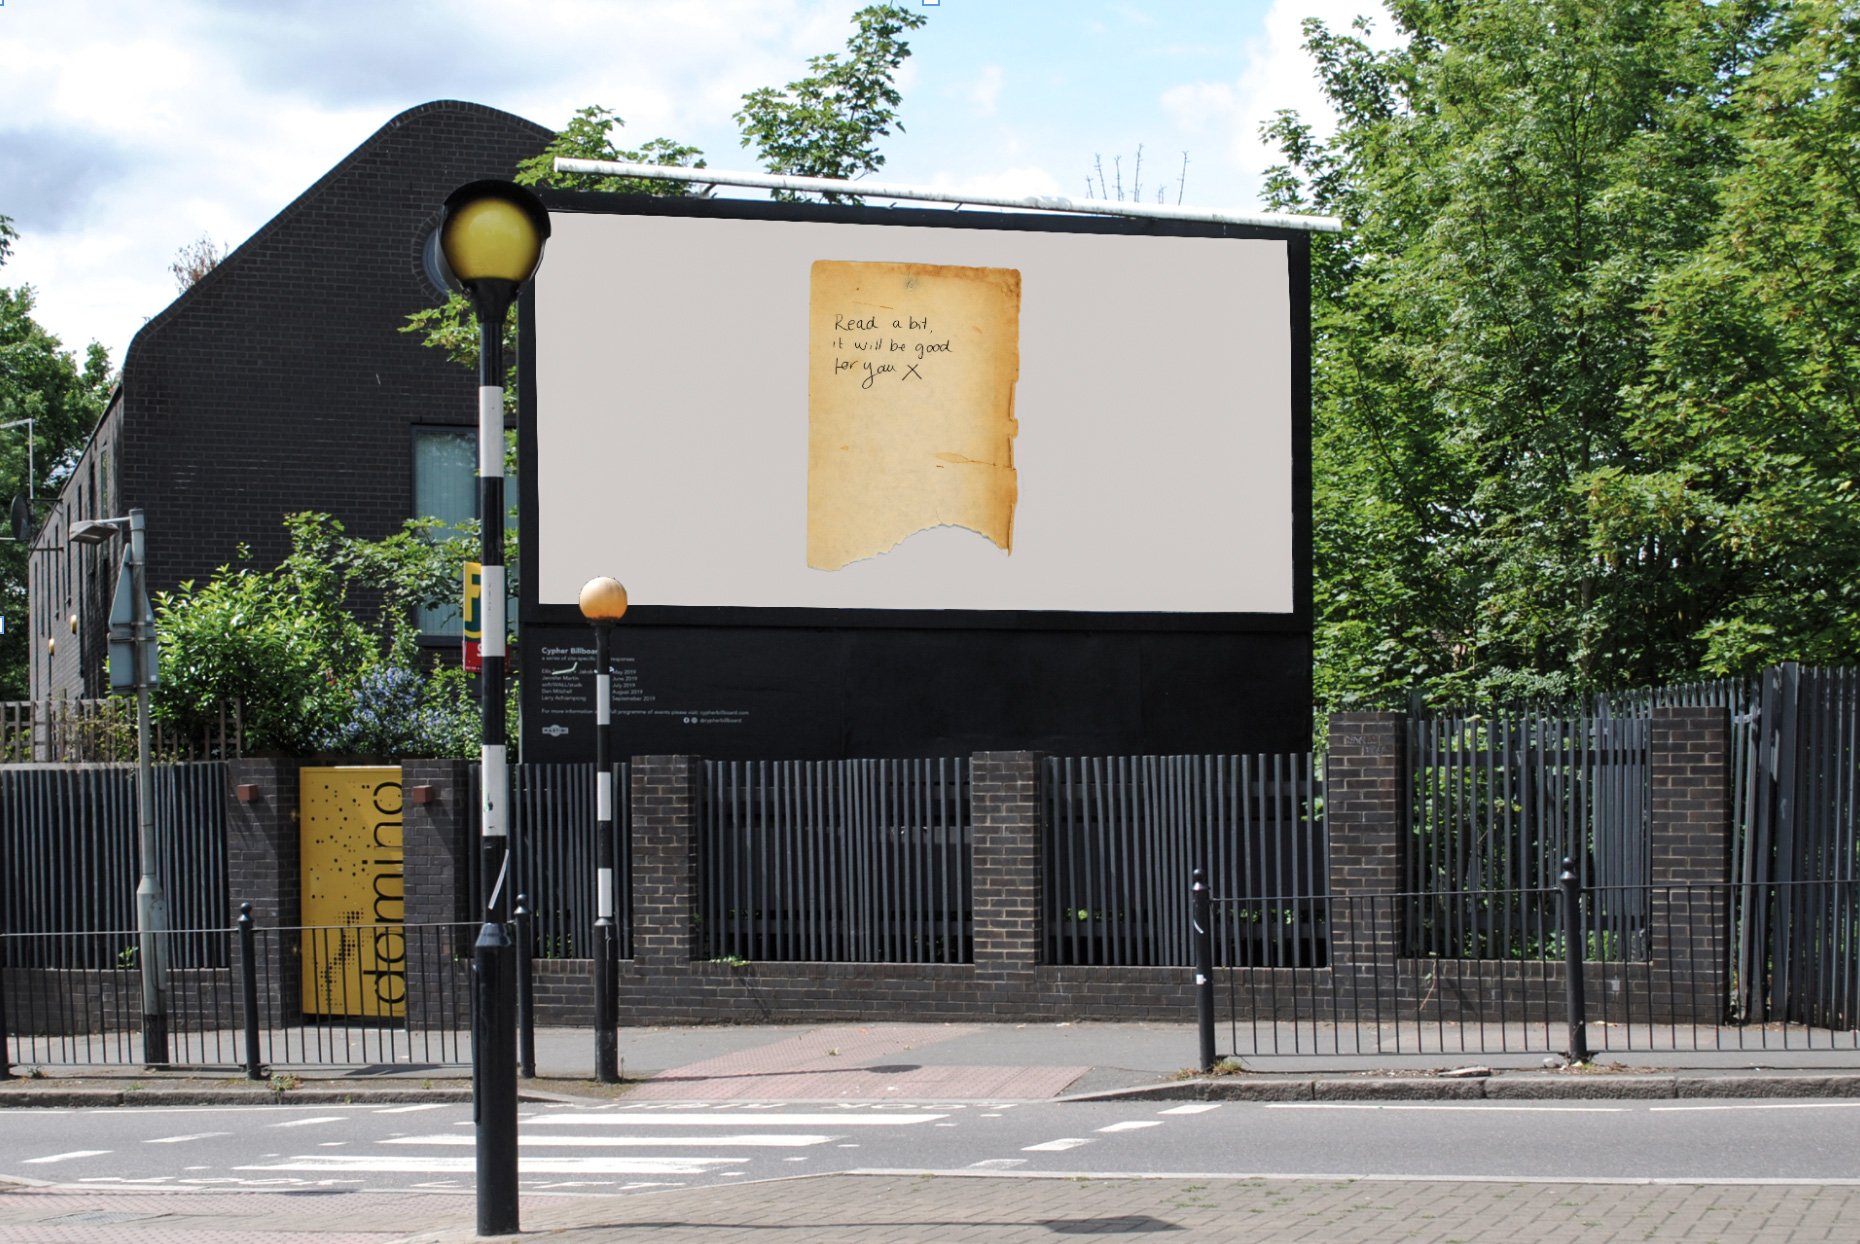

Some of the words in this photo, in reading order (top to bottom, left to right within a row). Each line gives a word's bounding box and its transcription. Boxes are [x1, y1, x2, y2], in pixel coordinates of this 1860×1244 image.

[835, 313, 878, 331] Read
[892, 319, 902, 329] a
[832, 337, 844, 349] it
[854, 338, 883, 350] will
[890, 338, 906, 352] be
[914, 339, 953, 360] good
[835, 357, 859, 375] for
[861, 361, 897, 390] you
[541, 647, 569, 656] Cypher
[570, 647, 599, 655] Billboar
[363, 782, 406, 1004] domino
